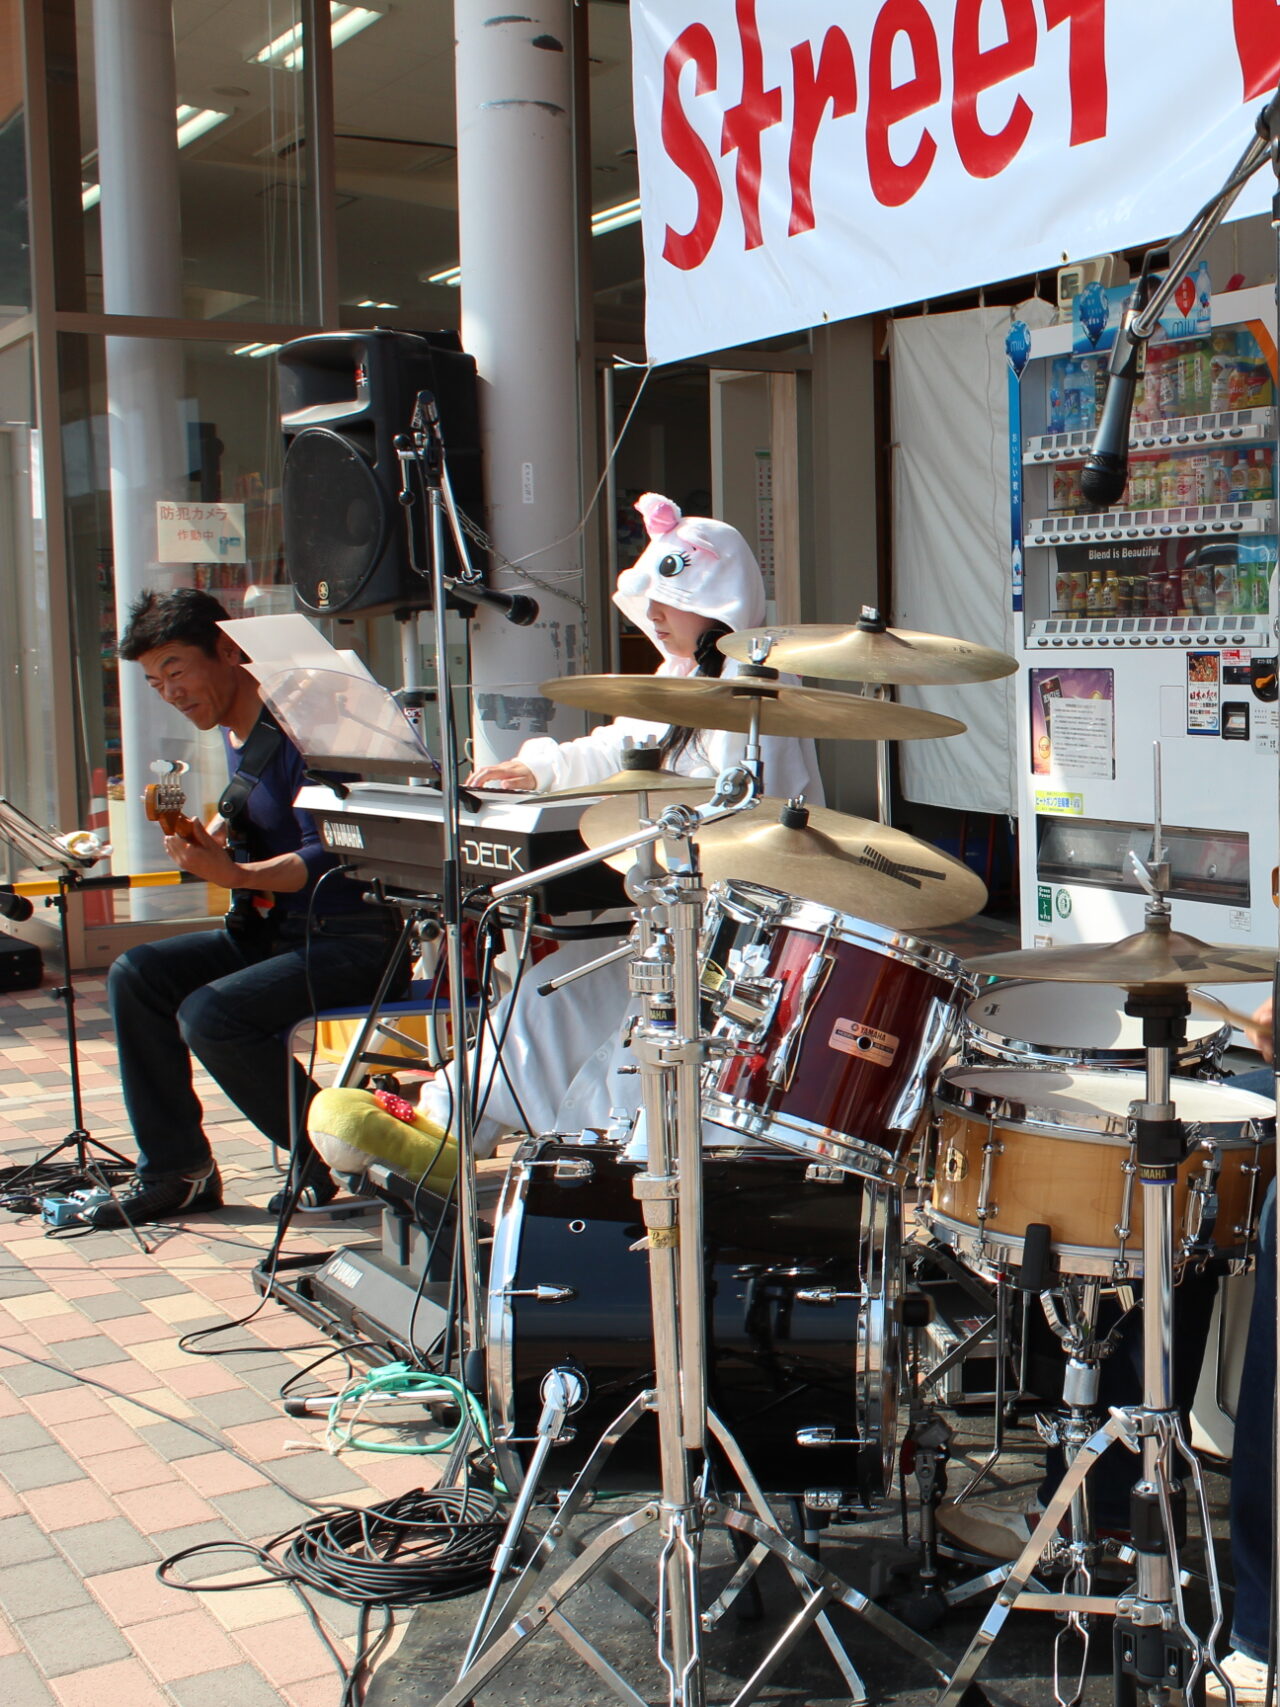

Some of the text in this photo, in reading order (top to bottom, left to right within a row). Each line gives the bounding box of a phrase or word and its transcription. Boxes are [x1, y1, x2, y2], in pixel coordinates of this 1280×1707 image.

[160, 506, 228, 521] 防犯カメラ
[177, 530, 214, 541] 作動中
[1088, 546, 1161, 560] Blend is Beautiful.
[332, 823, 365, 849] YAMAHA
[861, 1026, 886, 1042] YAMAHA
[331, 1260, 364, 1289] YAMAHA
